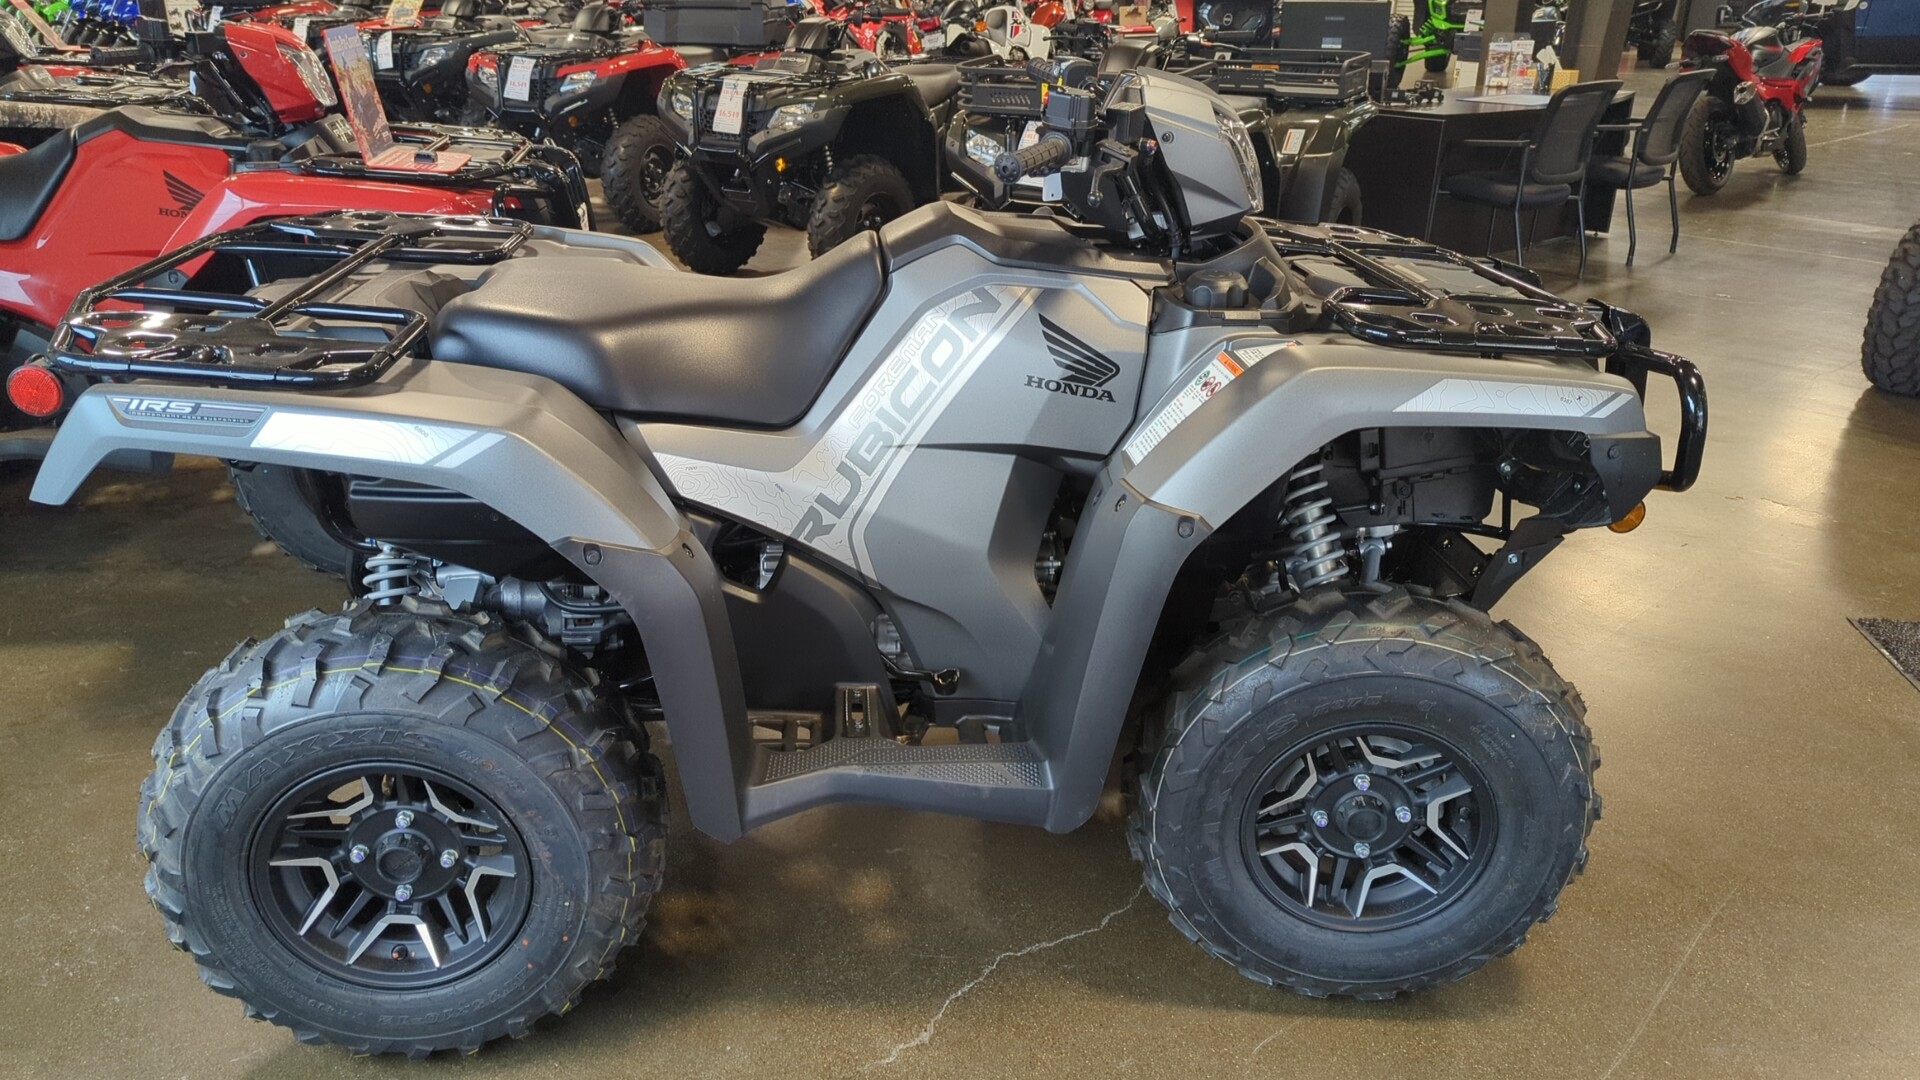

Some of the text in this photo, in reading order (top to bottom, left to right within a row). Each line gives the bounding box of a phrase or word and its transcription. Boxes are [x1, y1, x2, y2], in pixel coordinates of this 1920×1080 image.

[128, 399, 196, 414] IRS
[789, 286, 1002, 545] RUBICON
[848, 306, 951, 430] FOREMAN
[1023, 374, 1117, 403] HONDA
[216, 726, 443, 828] MAXXIS
